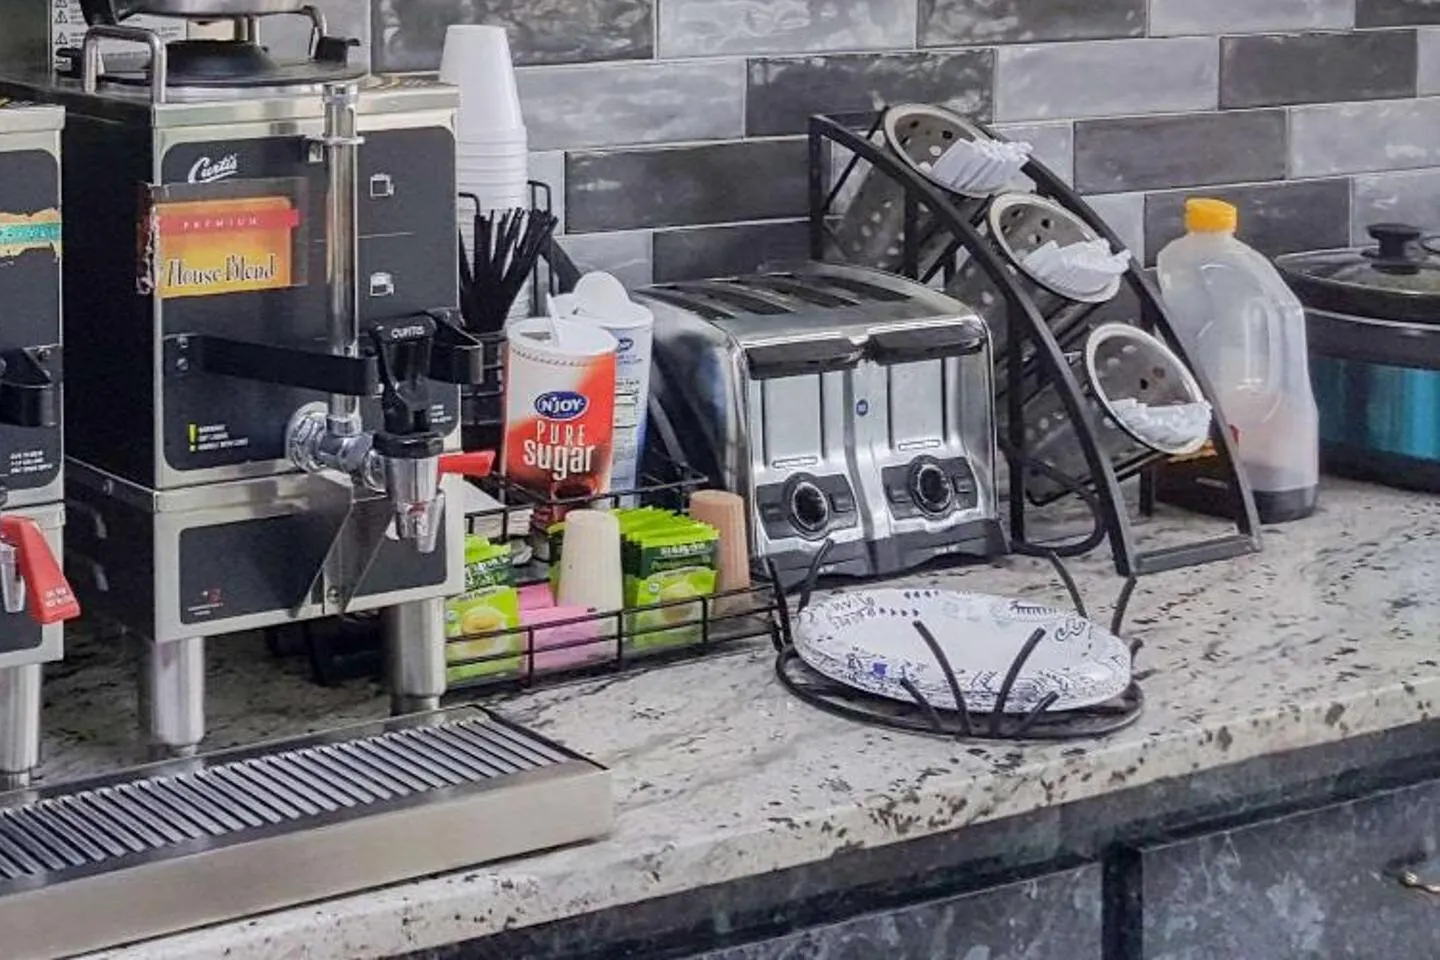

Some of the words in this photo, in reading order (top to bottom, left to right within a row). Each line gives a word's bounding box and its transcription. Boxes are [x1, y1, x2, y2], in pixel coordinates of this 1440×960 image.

[187, 152, 239, 184] Curtis
[182, 218, 259, 231] PREMIUM
[167, 256, 223, 288] House
[224, 252, 278, 282] Blend
[391, 325, 426, 339] CURTIS
[536, 419, 586, 447] PURE
